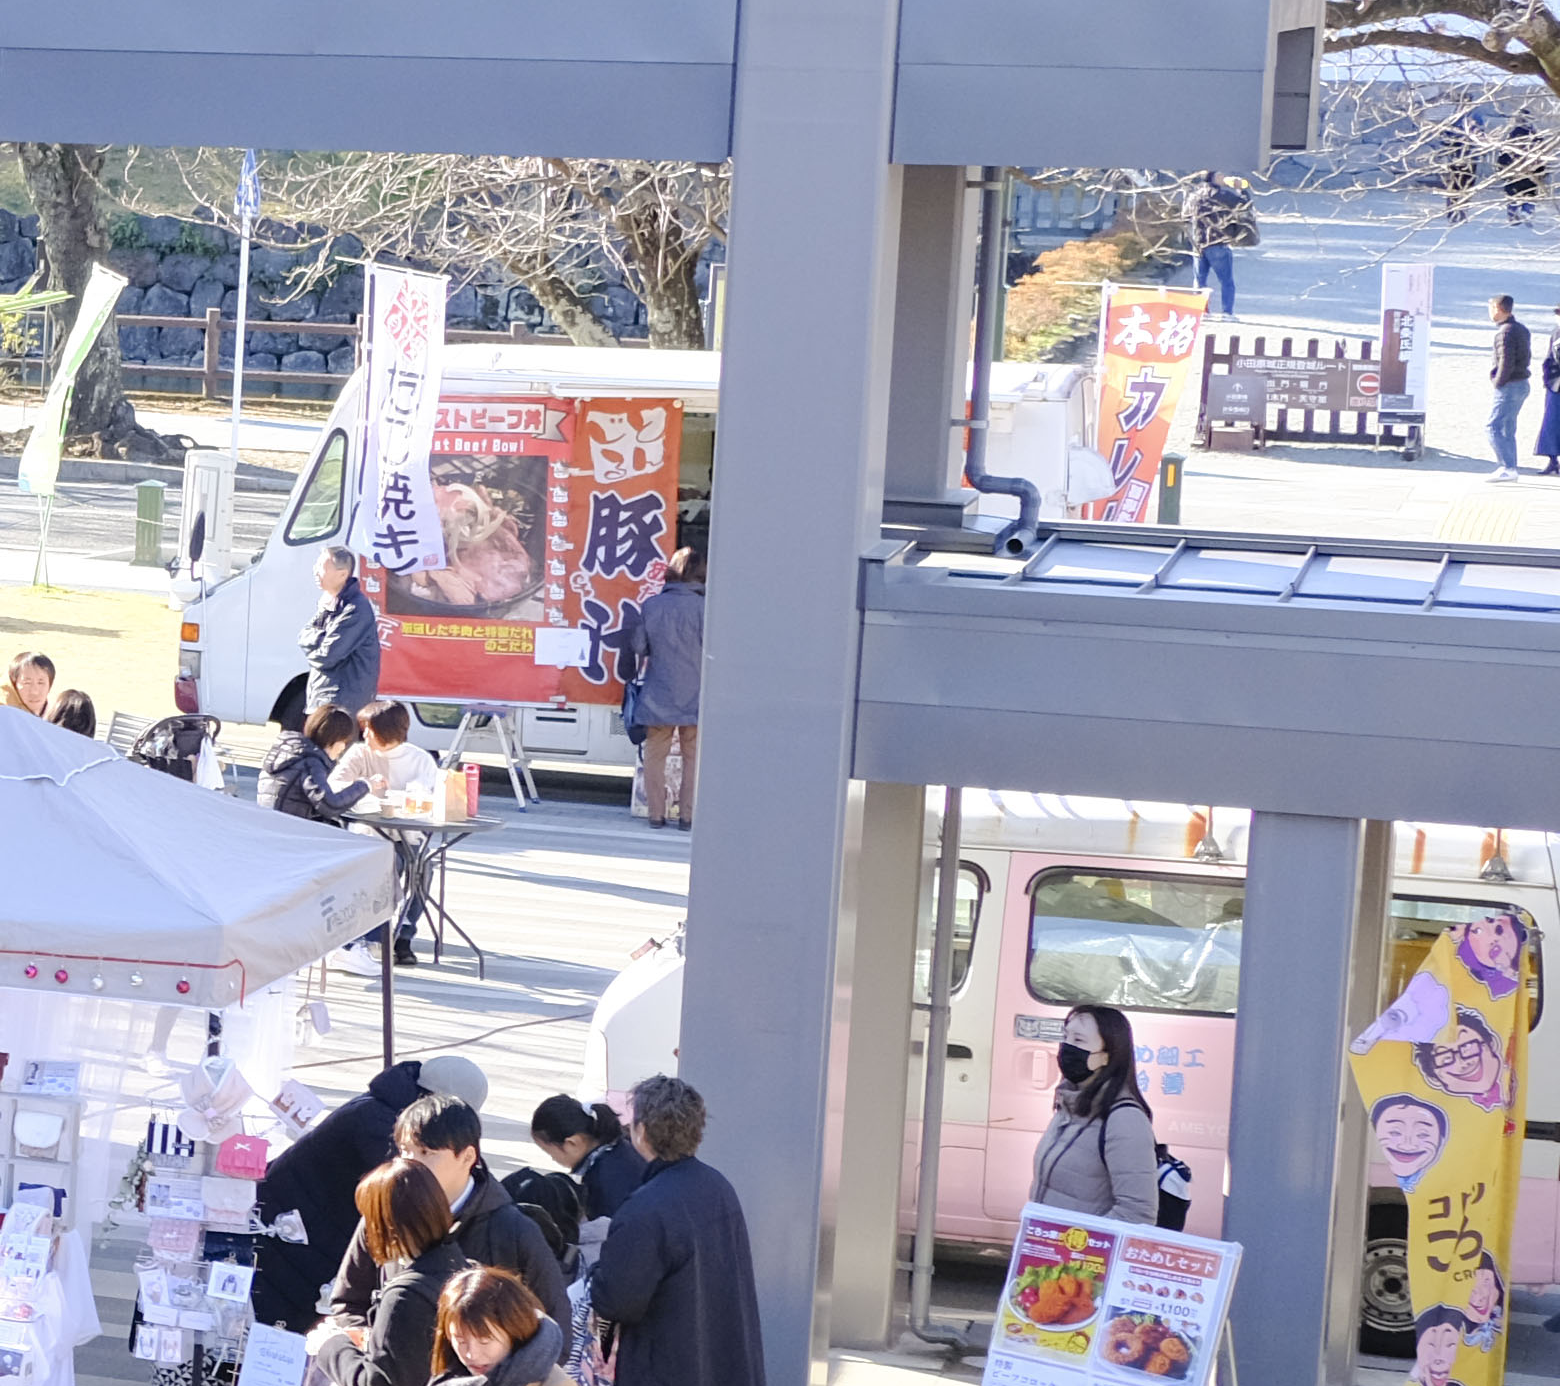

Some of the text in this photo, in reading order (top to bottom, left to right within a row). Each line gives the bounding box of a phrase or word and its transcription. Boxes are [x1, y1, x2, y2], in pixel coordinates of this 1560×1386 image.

[1113, 305, 1197, 356] 本格
[1124, 1247, 1215, 1273] おためしセット
